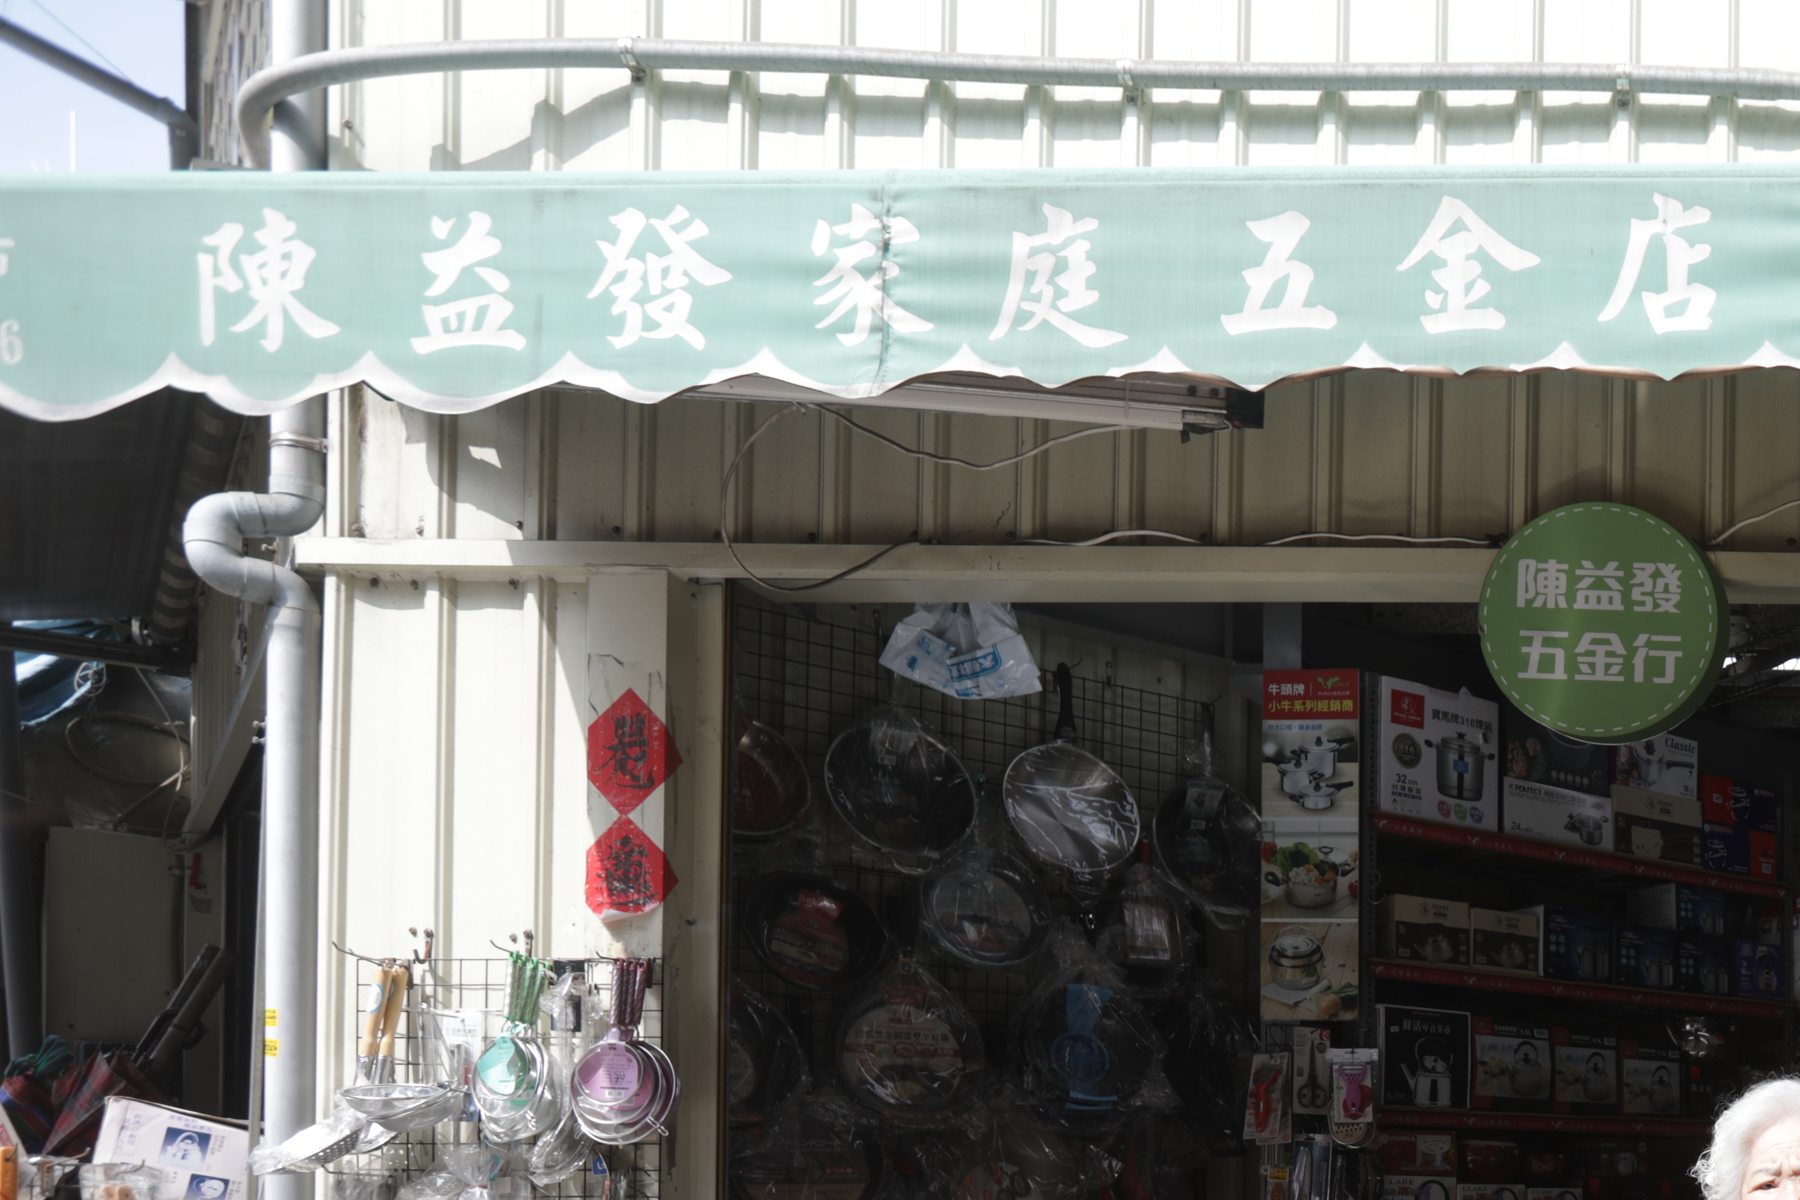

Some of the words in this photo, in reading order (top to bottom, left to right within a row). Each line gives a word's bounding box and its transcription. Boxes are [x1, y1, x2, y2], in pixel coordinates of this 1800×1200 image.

[196, 194, 1717, 353] 陳益發家庭五金店
[1516, 558, 1683, 614] 陳益發
[1517, 629, 1683, 684] 五金行
[1267, 683, 1306, 696] 牛頭牌
[1267, 699, 1354, 713] 小牛系列經銷商
[1665, 736, 1697, 755] Classic
[1395, 772, 1408, 785] 32
[1514, 783, 1542, 796] PERFECT
